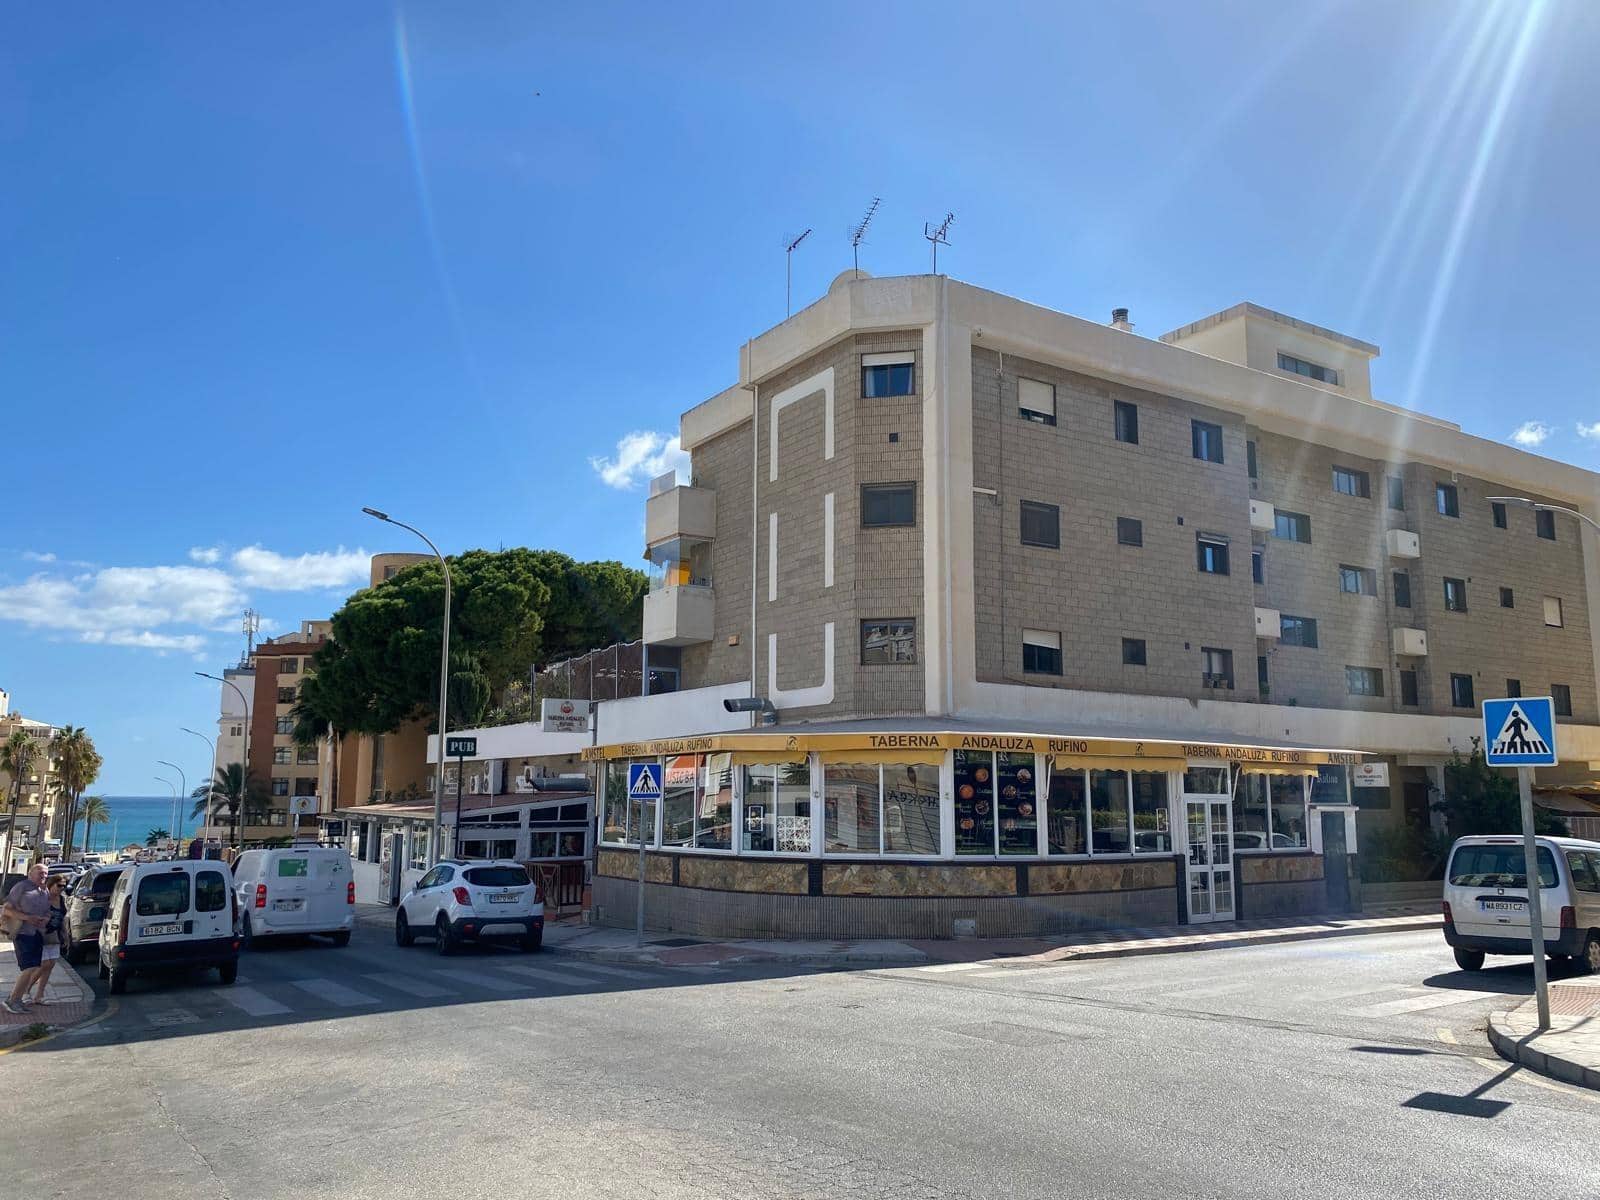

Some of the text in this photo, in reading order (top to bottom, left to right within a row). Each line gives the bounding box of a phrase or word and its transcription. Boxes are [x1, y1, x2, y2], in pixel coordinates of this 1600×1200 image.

[450, 741, 475, 752] PUB
[585, 738, 713, 759] AMSTEL TABERNA ANDALUZA RUFINO
[870, 735, 1088, 753] TABERNA ANDALUZA RUFINO
[1182, 746, 1300, 762] TABERNA ANDALUZA RUFINO
[1327, 753, 1357, 765] AMSTEL
